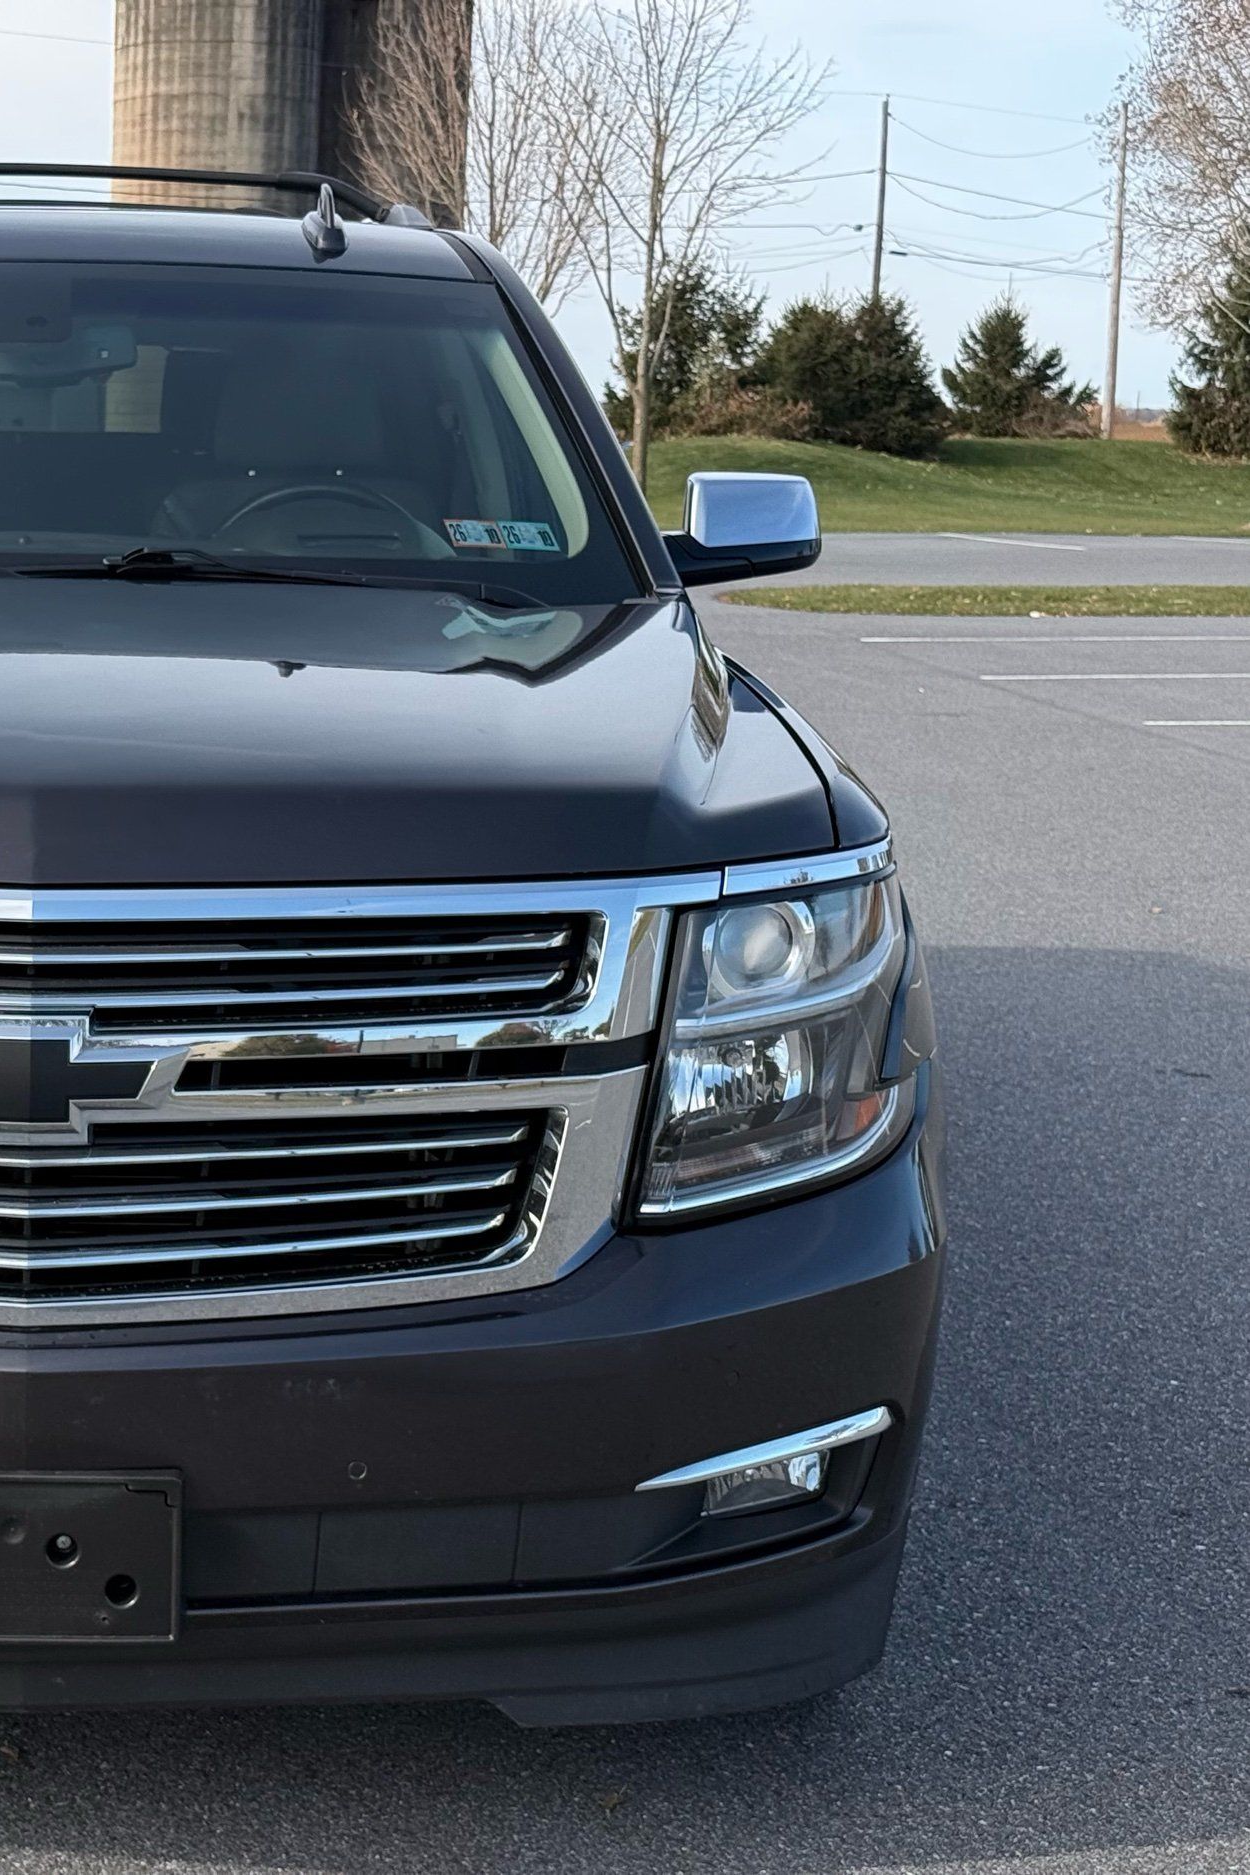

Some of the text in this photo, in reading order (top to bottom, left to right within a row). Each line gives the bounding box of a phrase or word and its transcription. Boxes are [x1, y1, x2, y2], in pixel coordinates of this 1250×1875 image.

[449, 523, 502, 544] 26 10
[502, 525, 555, 547] 26 10
